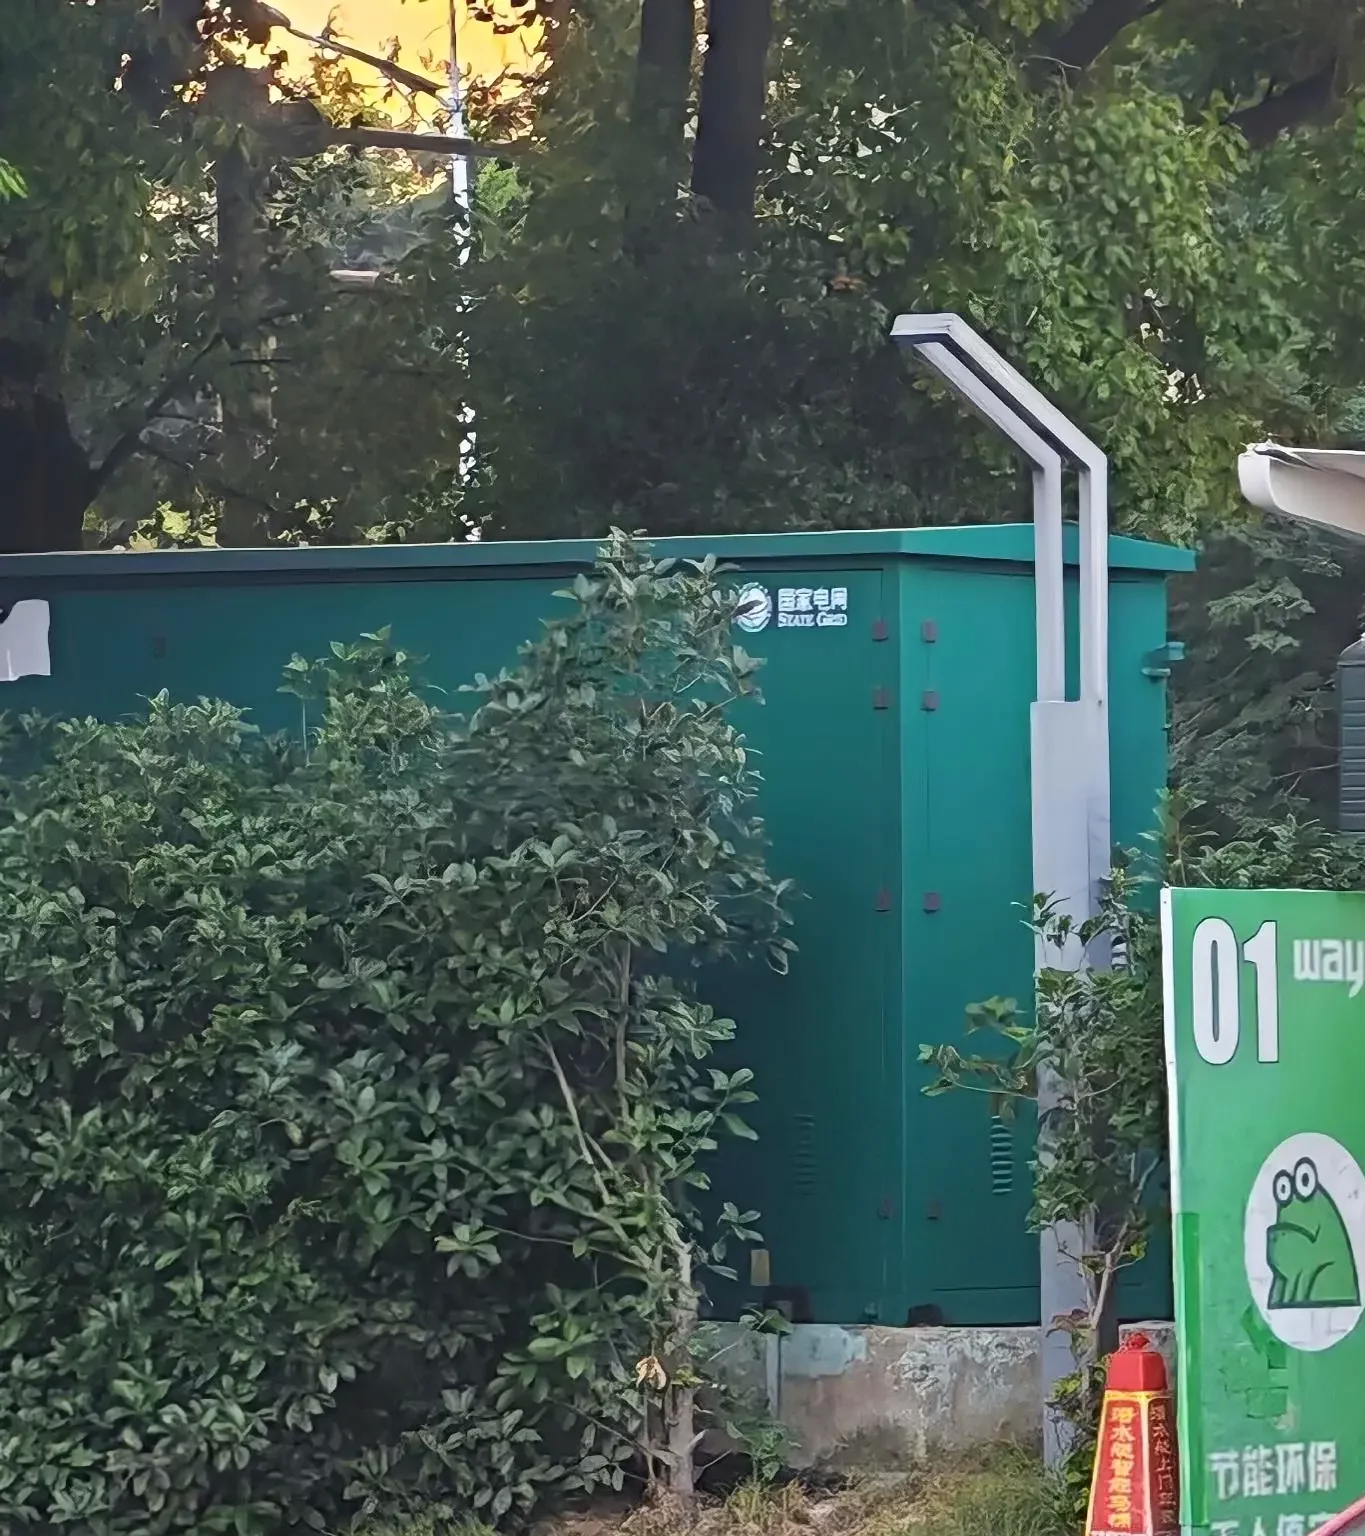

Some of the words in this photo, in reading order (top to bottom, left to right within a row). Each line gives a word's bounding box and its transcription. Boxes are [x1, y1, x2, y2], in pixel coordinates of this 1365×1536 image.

[1193, 917, 1279, 1065] 01
[1210, 1441, 1337, 1499] 节能环保
